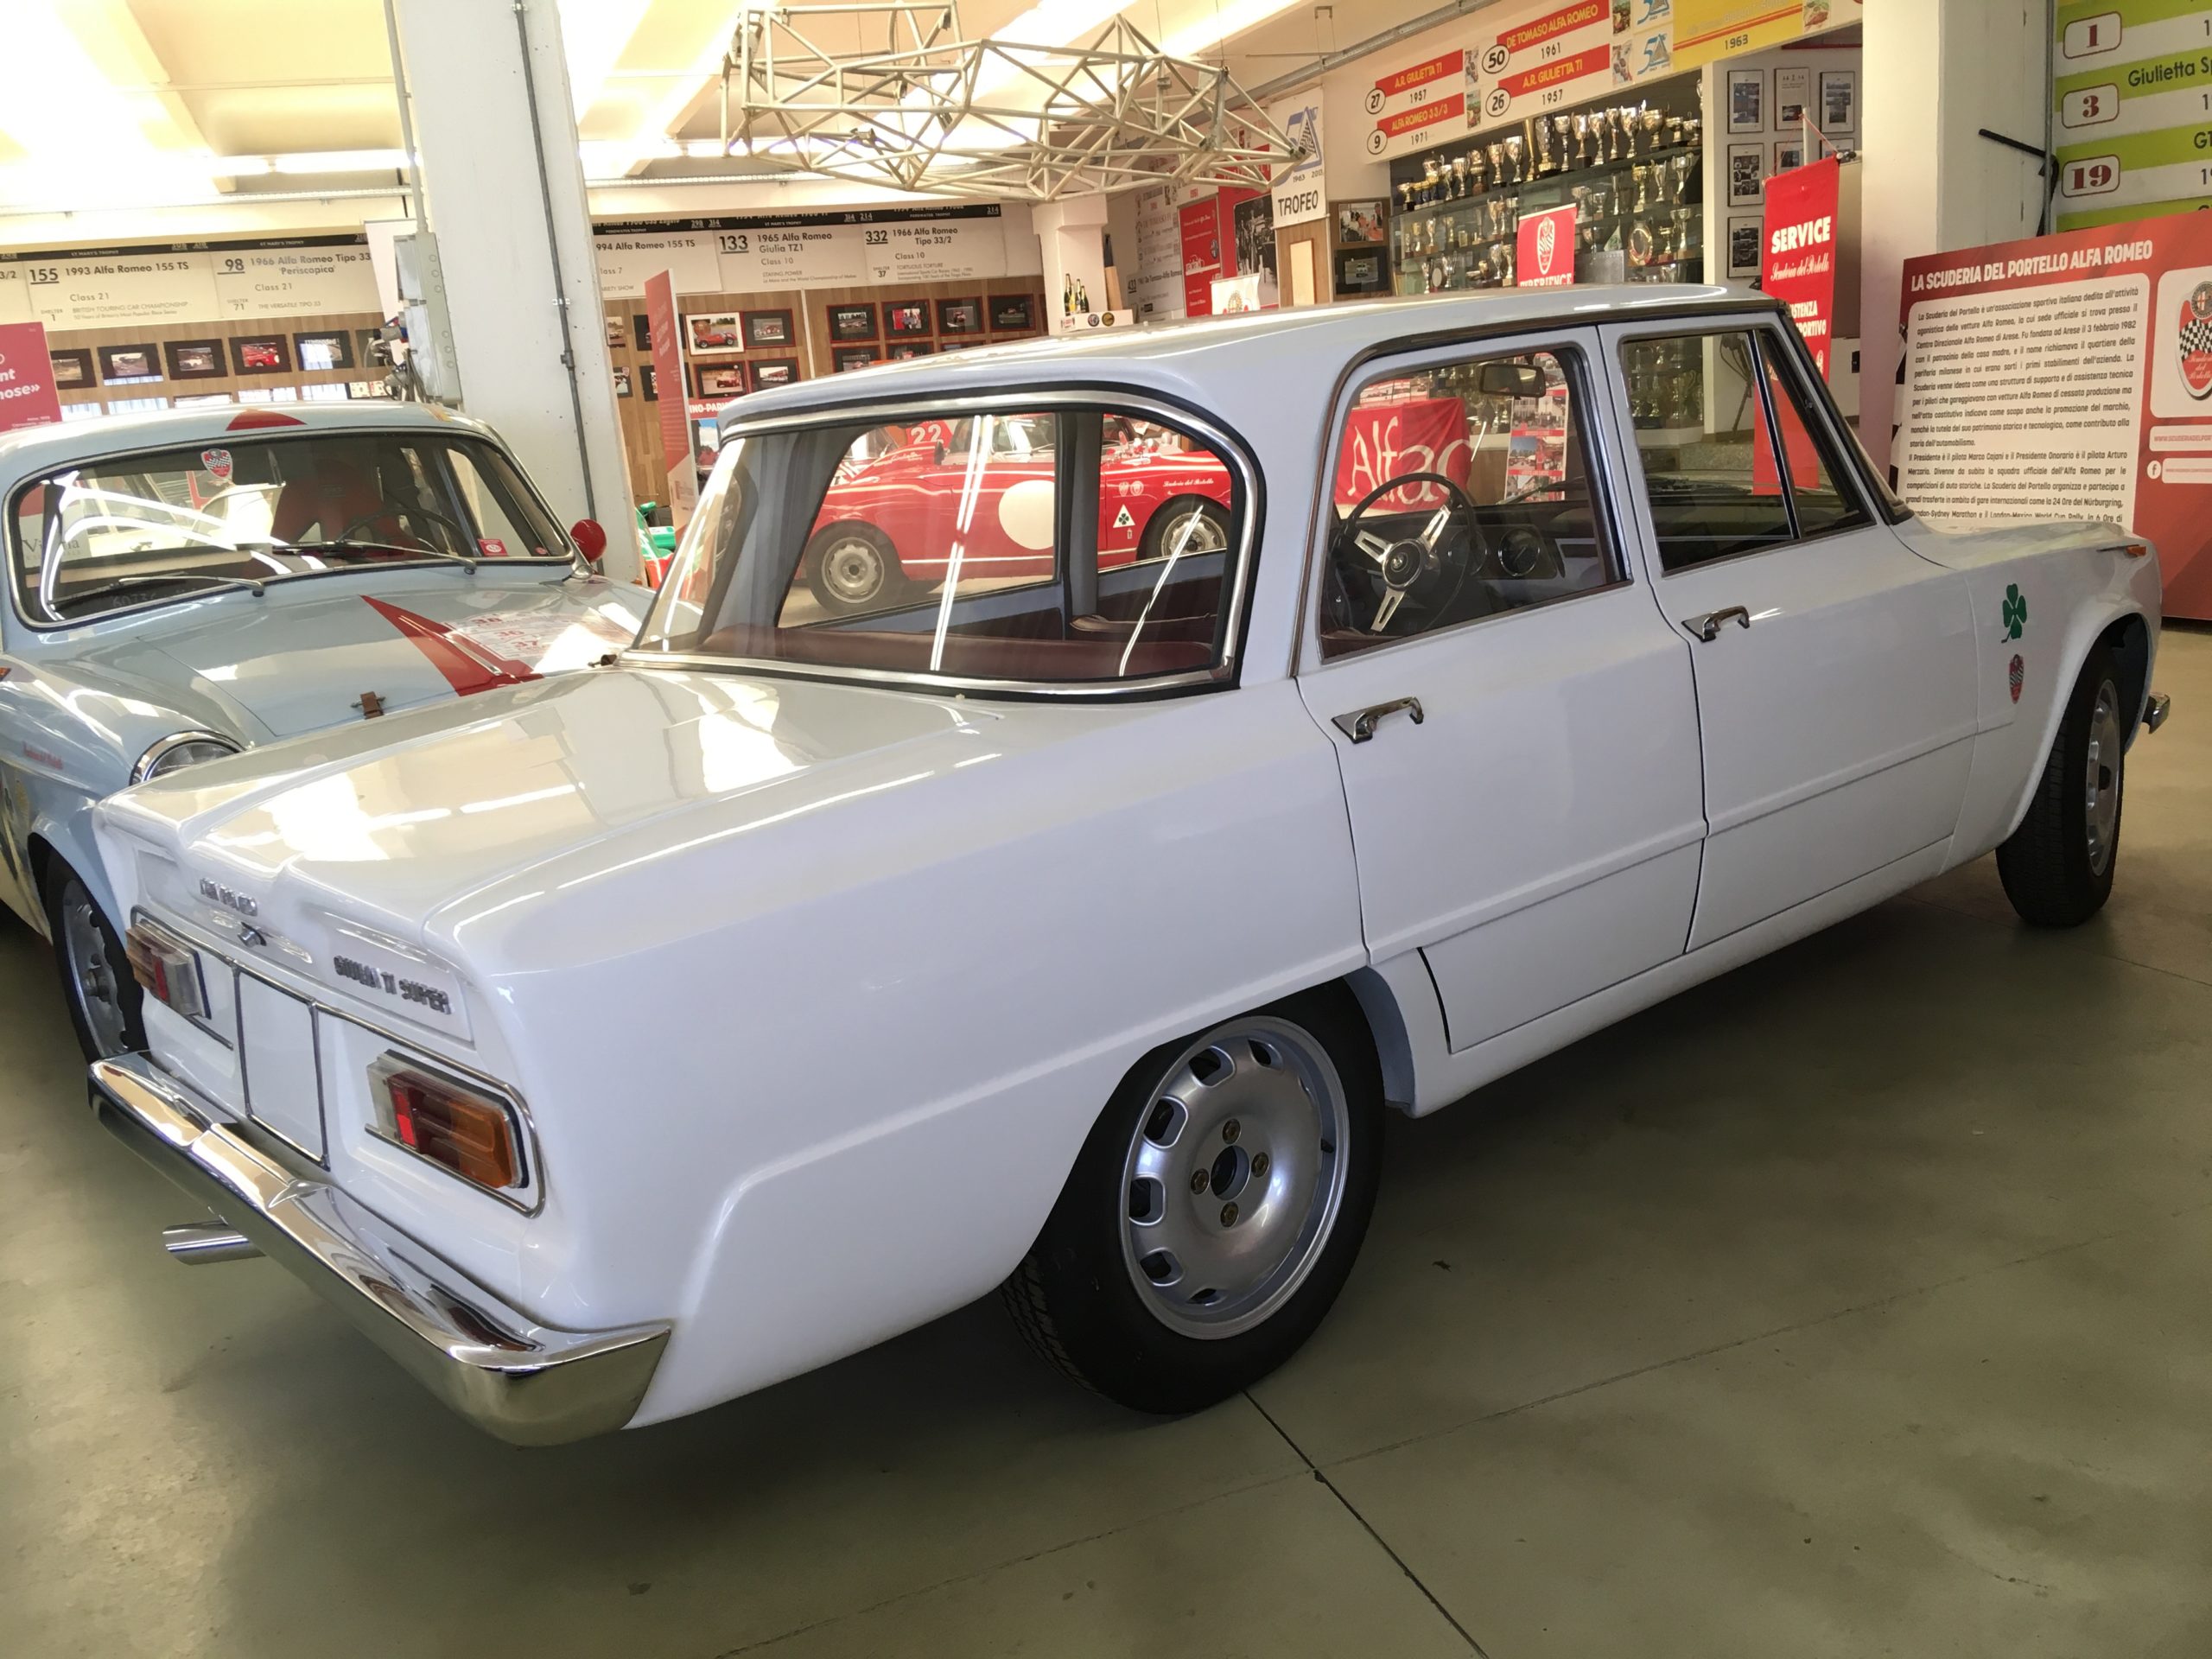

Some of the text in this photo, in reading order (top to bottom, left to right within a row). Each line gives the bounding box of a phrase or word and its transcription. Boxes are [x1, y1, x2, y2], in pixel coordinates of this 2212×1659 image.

[1507, 4, 1599, 48] DE TOMASO ALFA ROMEO
[1725, 35, 1749, 50] 1963
[2087, 24, 2100, 48] 1
[1488, 50, 1505, 69] 50
[1541, 42, 1560, 59] 1961
[1407, 66, 1435, 84] GIULIETTA
[1436, 62, 1443, 73] TI
[1538, 63, 1574, 84] GIULIETTA
[1575, 59, 1583, 71] TI
[2127, 60, 2195, 87] Giulietta
[1370, 93, 1381, 109] 27
[1410, 89, 1427, 104] 1957
[1491, 93, 1505, 111] 26
[1541, 89, 1563, 105] 1957
[2082, 95, 2100, 118] 3
[1392, 121, 1404, 131] ALFA
[1405, 111, 1427, 126] ROMEO
[1374, 135, 1381, 149] 9
[1411, 131, 1427, 145] 1971
[1293, 175, 1305, 183] 1963
[2070, 164, 2112, 190] 19
[1278, 190, 1319, 216] TROFEO
[802, 232, 832, 240] Romeo
[866, 230, 888, 242] 332
[931, 226, 957, 235] Romeo
[1771, 216, 1832, 254] SERVICE
[615, 242, 632, 251] Alfa
[719, 235, 748, 251] 133
[915, 237, 931, 245] Tipo
[225, 259, 244, 271] 98
[250, 257, 275, 266] 1966
[278, 256, 297, 264] Alfa
[335, 254, 356, 263] Tipo
[1797, 257, 1808, 276] del
[1911, 240, 2153, 292] LA SCUDERIA DEL PORTELLO ALFA ROMEO
[29, 268, 58, 283] 155
[66, 267, 90, 276] 1993
[94, 265, 114, 275] Alfa
[118, 264, 152, 273] Romeo
[156, 263, 175, 271] 155
[69, 292, 109, 302] Class 21
[1918, 313, 1924, 321] La
[1925, 311, 1948, 320] Scuderia
[1959, 306, 1980, 315] Portello
[1986, 302, 2031, 313] un'associazione
[2033, 297, 2058, 309] sportiva
[2059, 294, 2082, 304] italiana
[2083, 292, 2103, 302] dedita
[2105, 289, 2139, 298] all'attività
[1790, 301, 1818, 319] STENZA
[1917, 302, 2138, 336] agonistica delle vetture Alfa Romeo, la cui sede ufficiale si trova presso il
[1796, 319, 1827, 337] PORTIVO
[1935, 337, 1963, 347] Direzionale
[1976, 335, 1994, 344] Romeo
[2003, 332, 2020, 340] Arese.
[2022, 330, 2029, 339] Fu
[2030, 328, 2052, 338] fondata
[2054, 327, 2062, 335] ad
[2063, 325, 2081, 335] Arese
[2082, 325, 2086, 334] il
[2093, 321, 2119, 332] febbraio
[2120, 320, 2136, 329] 1982
[911, 423, 944, 444] 22
[399, 979, 452, 1014] SUPER
